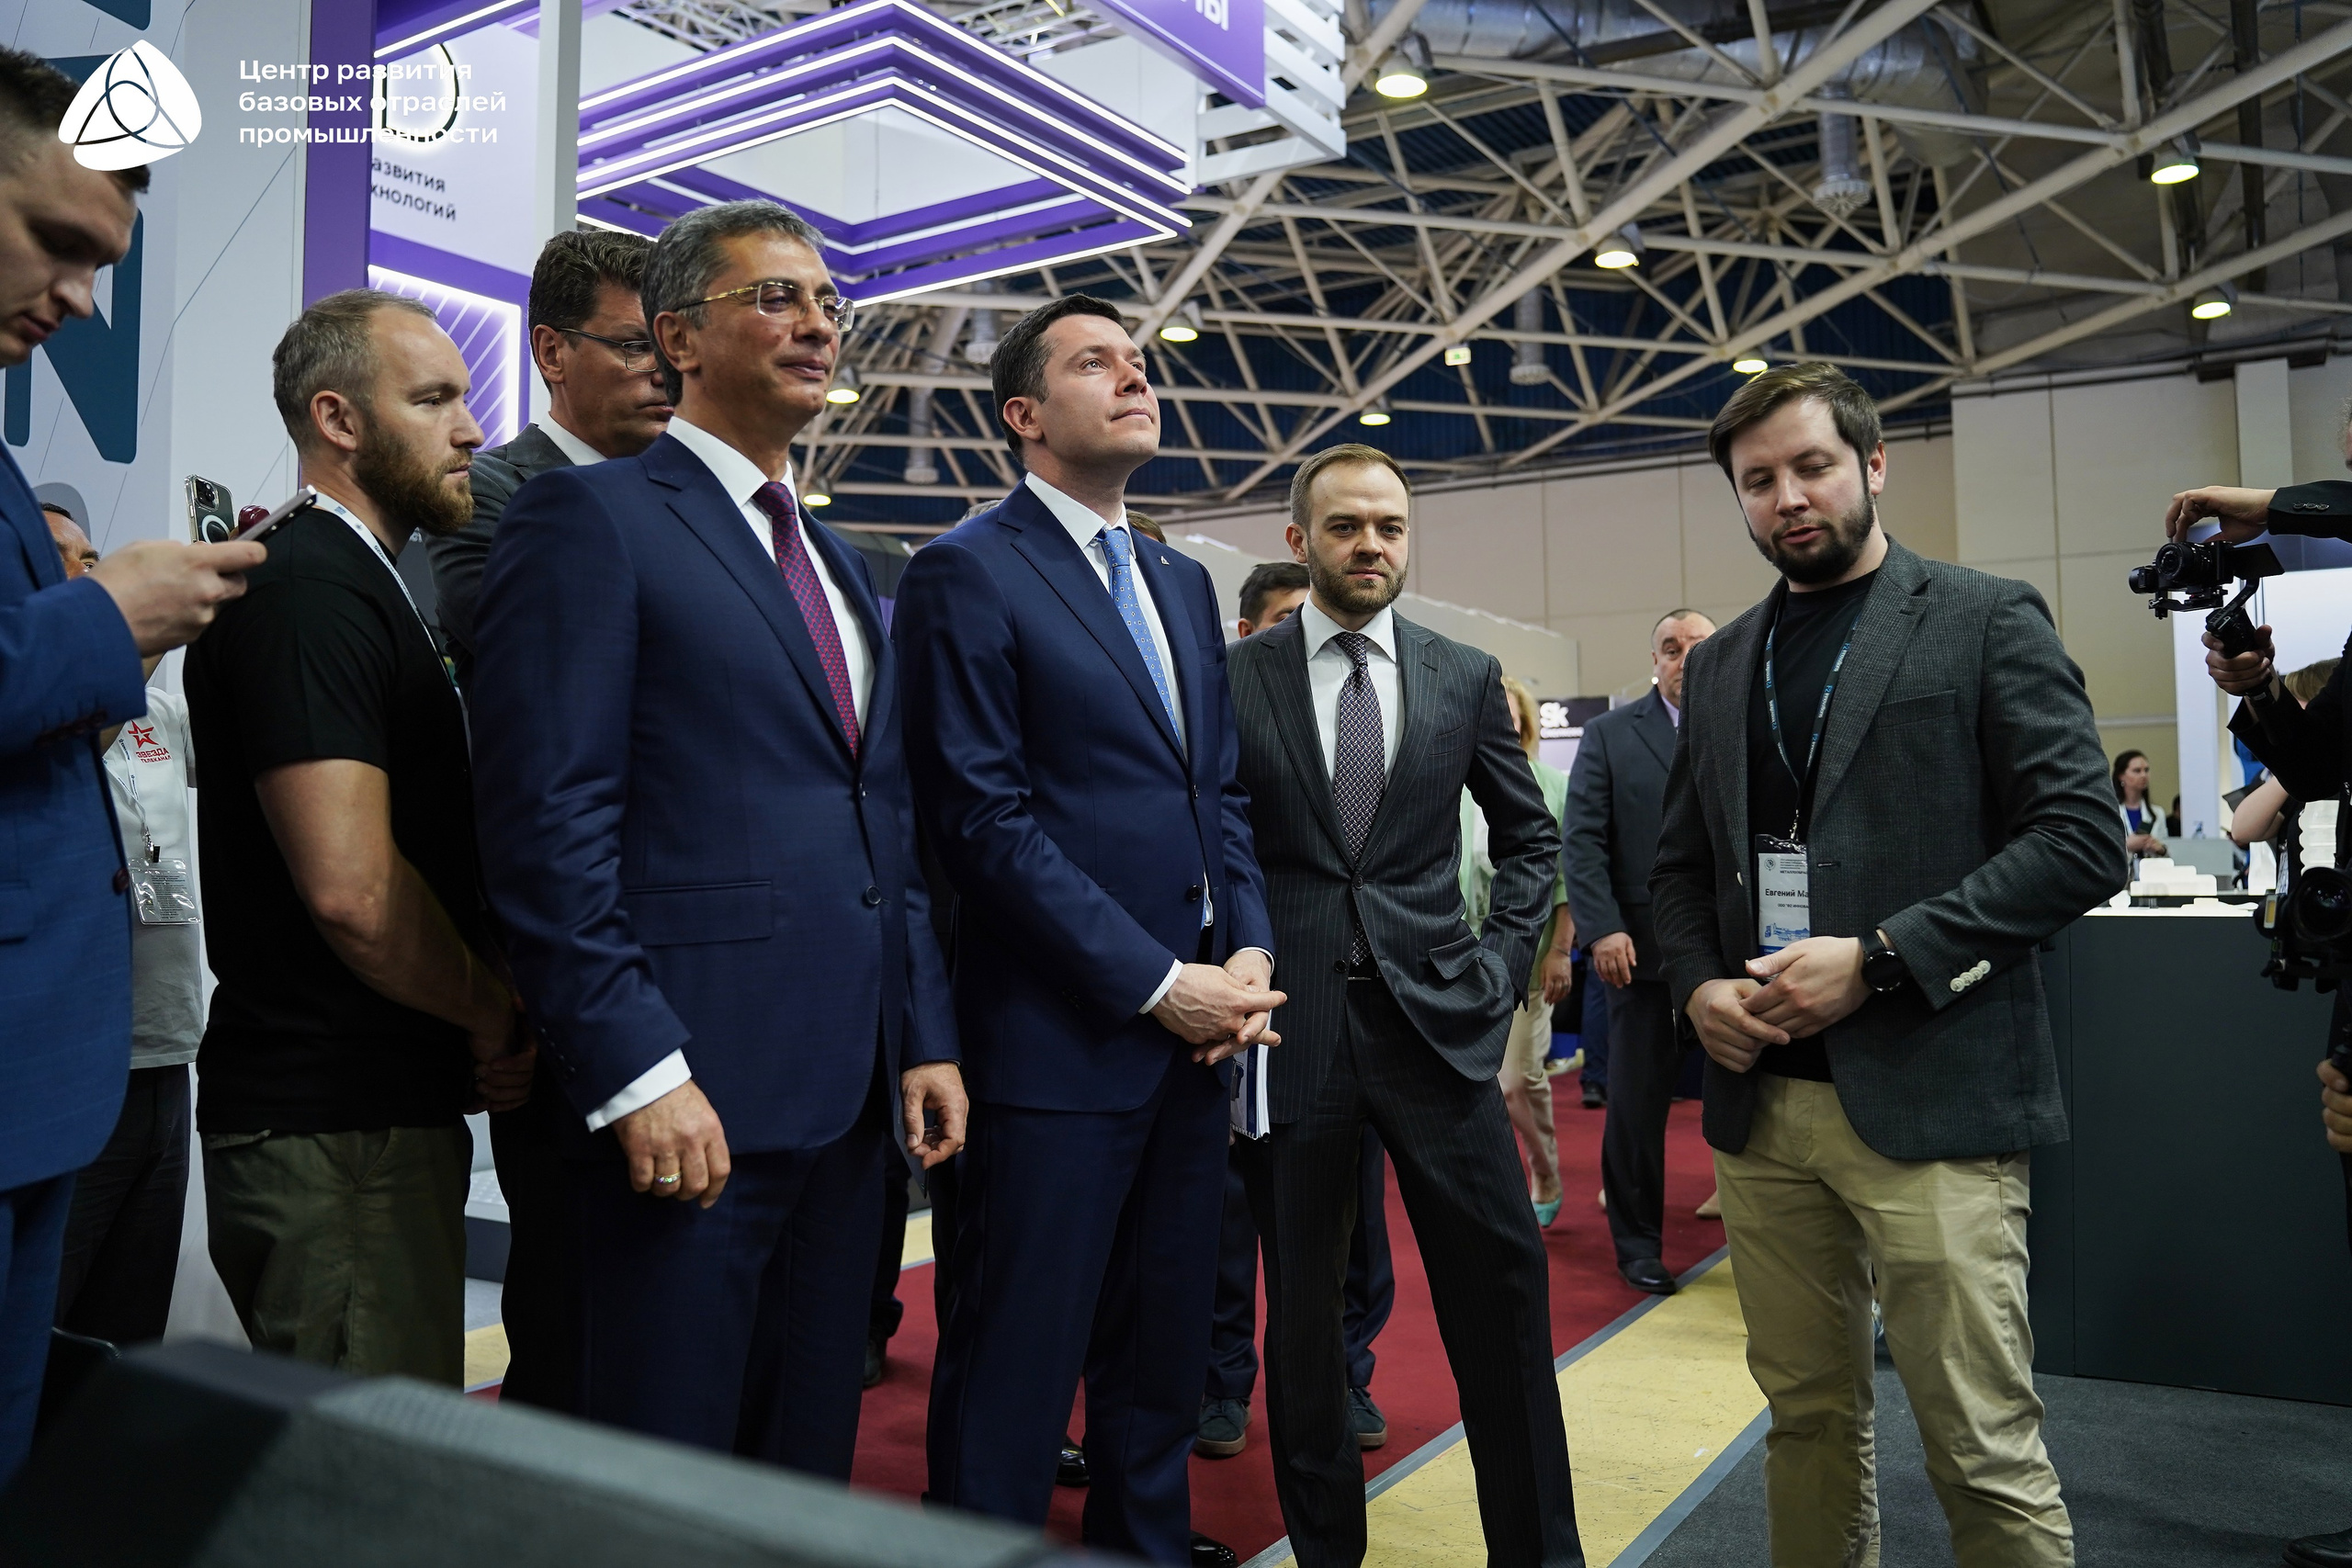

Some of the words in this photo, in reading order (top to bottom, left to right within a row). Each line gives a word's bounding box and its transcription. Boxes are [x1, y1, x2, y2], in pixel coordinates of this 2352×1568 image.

[371, 157, 446, 193] азвития
[136, 748, 169, 758] ЗВЕЗДА
[1765, 888, 1795, 897] Евгений
